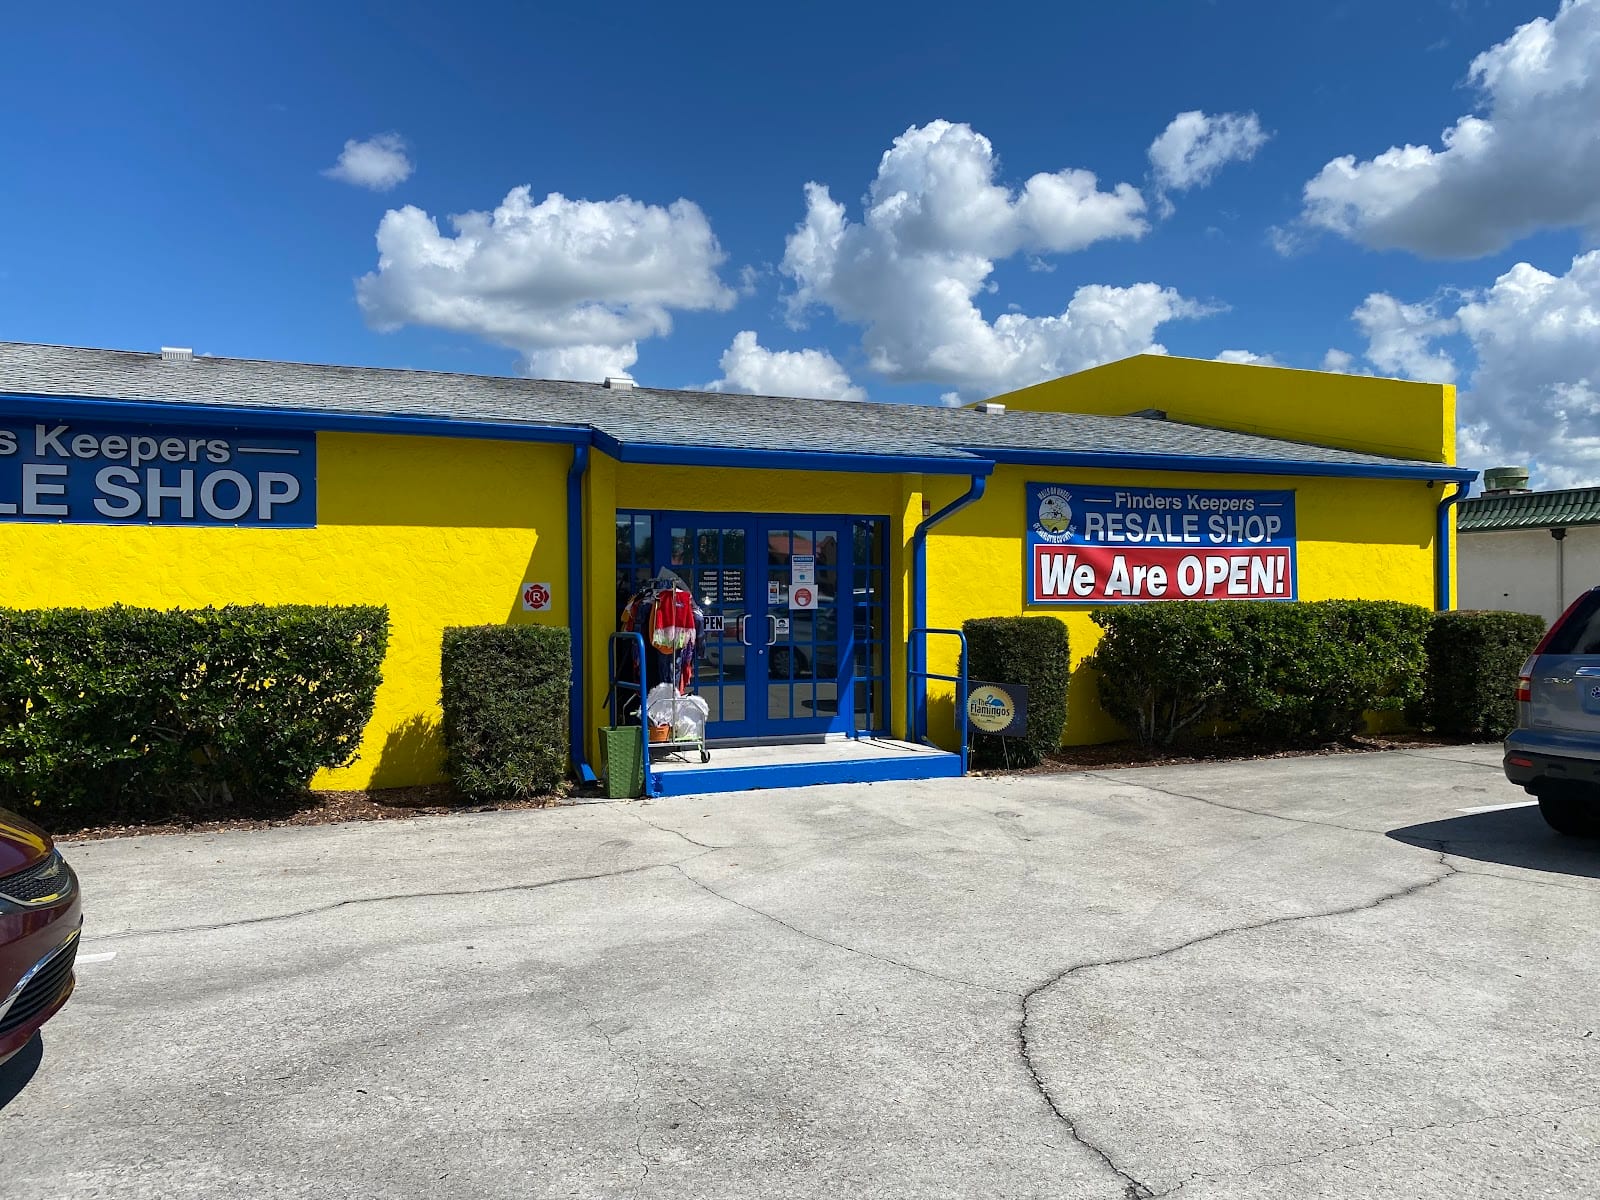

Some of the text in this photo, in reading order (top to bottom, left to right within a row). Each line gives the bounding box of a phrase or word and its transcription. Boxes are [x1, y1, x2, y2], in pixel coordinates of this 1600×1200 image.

[35, 424, 231, 467] Keepers
[93, 465, 300, 520] SHOP
[1115, 492, 1255, 514] Finders Keepers
[1084, 512, 1282, 544] RESALE SHOP
[1040, 553, 1286, 597] We Are OPEN!
[532, 592, 541, 601] R
[703, 616, 723, 630] PEN
[970, 703, 1010, 717] Flamingos
